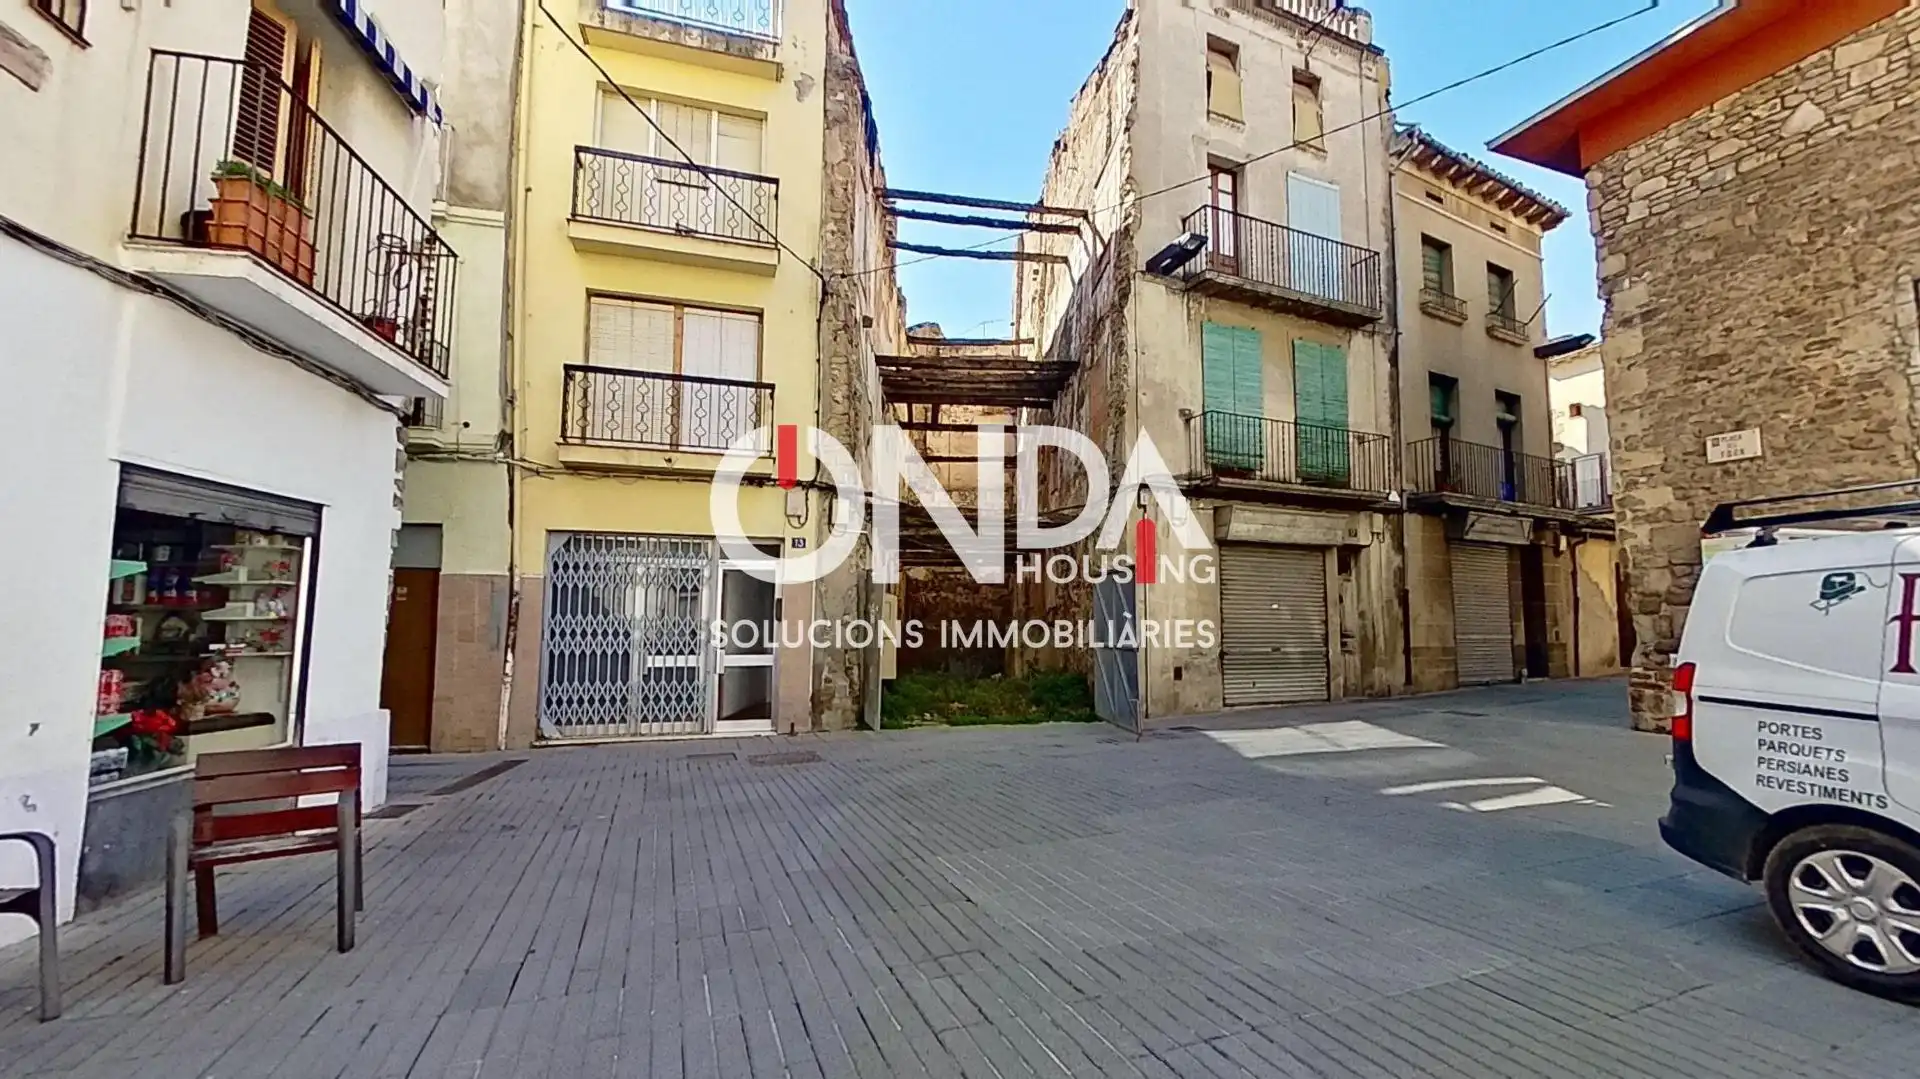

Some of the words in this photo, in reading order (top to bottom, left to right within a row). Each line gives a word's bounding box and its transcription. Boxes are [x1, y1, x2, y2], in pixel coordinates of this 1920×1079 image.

[1758, 720, 1823, 740] PORTES
[1758, 739, 1845, 762] PARQUETS
[1757, 757, 1849, 782] PERSIANES
[1756, 774, 1888, 809] REVESTIMENTS
